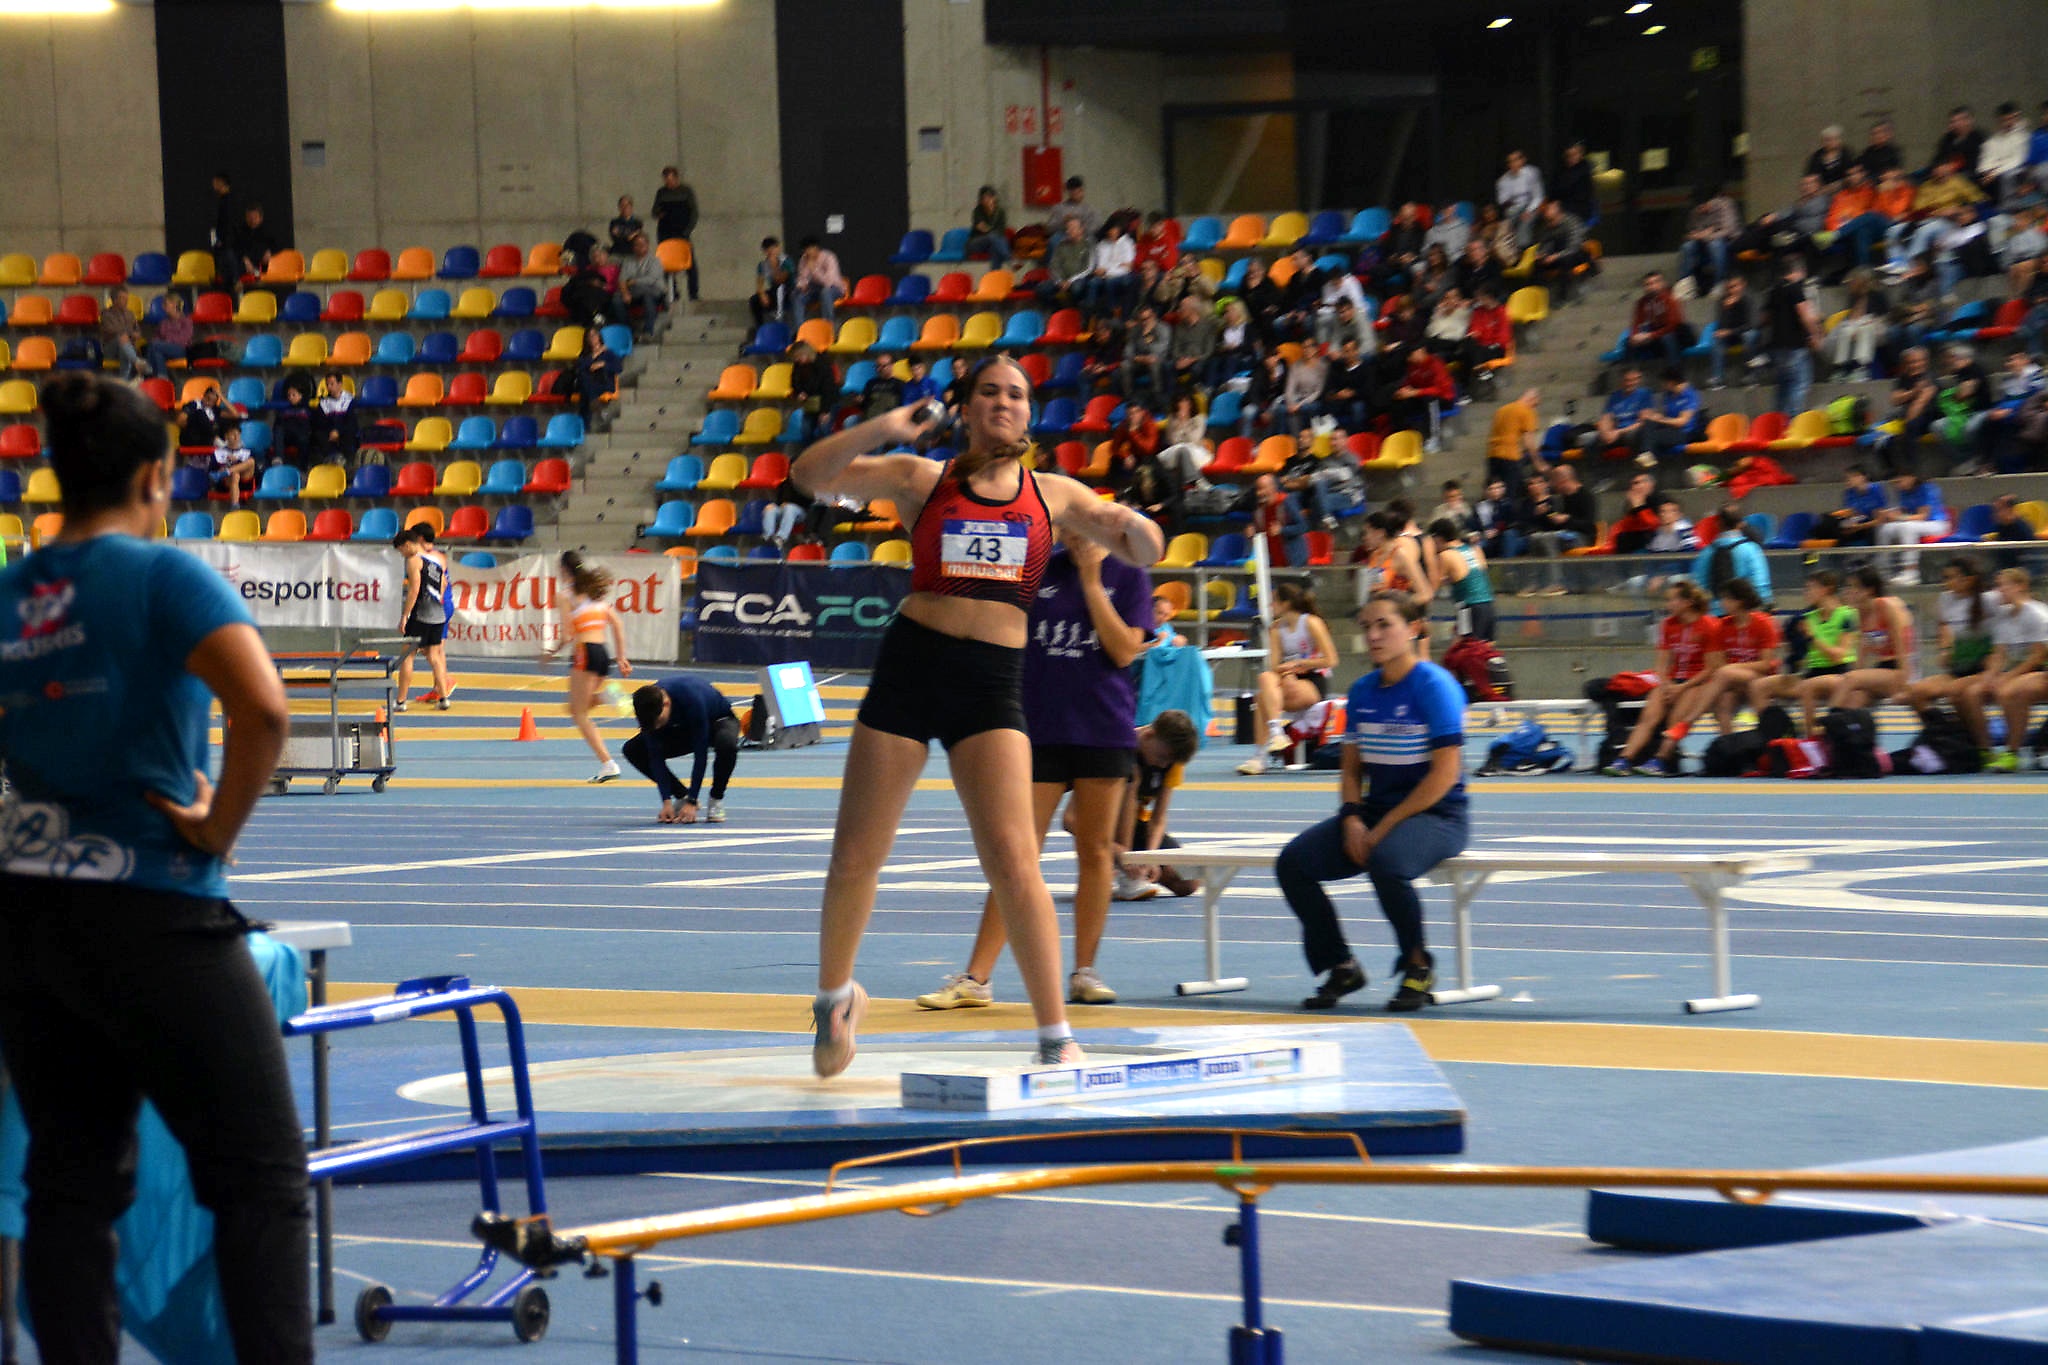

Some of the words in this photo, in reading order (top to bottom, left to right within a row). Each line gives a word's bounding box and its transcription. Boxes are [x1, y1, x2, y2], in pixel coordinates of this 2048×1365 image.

[966, 537, 1001, 562] 43
[240, 577, 381, 606] esportcat
[451, 571, 664, 615] utuat
[700, 590, 812, 627] FCA
[448, 621, 566, 643] SEGURANCE
